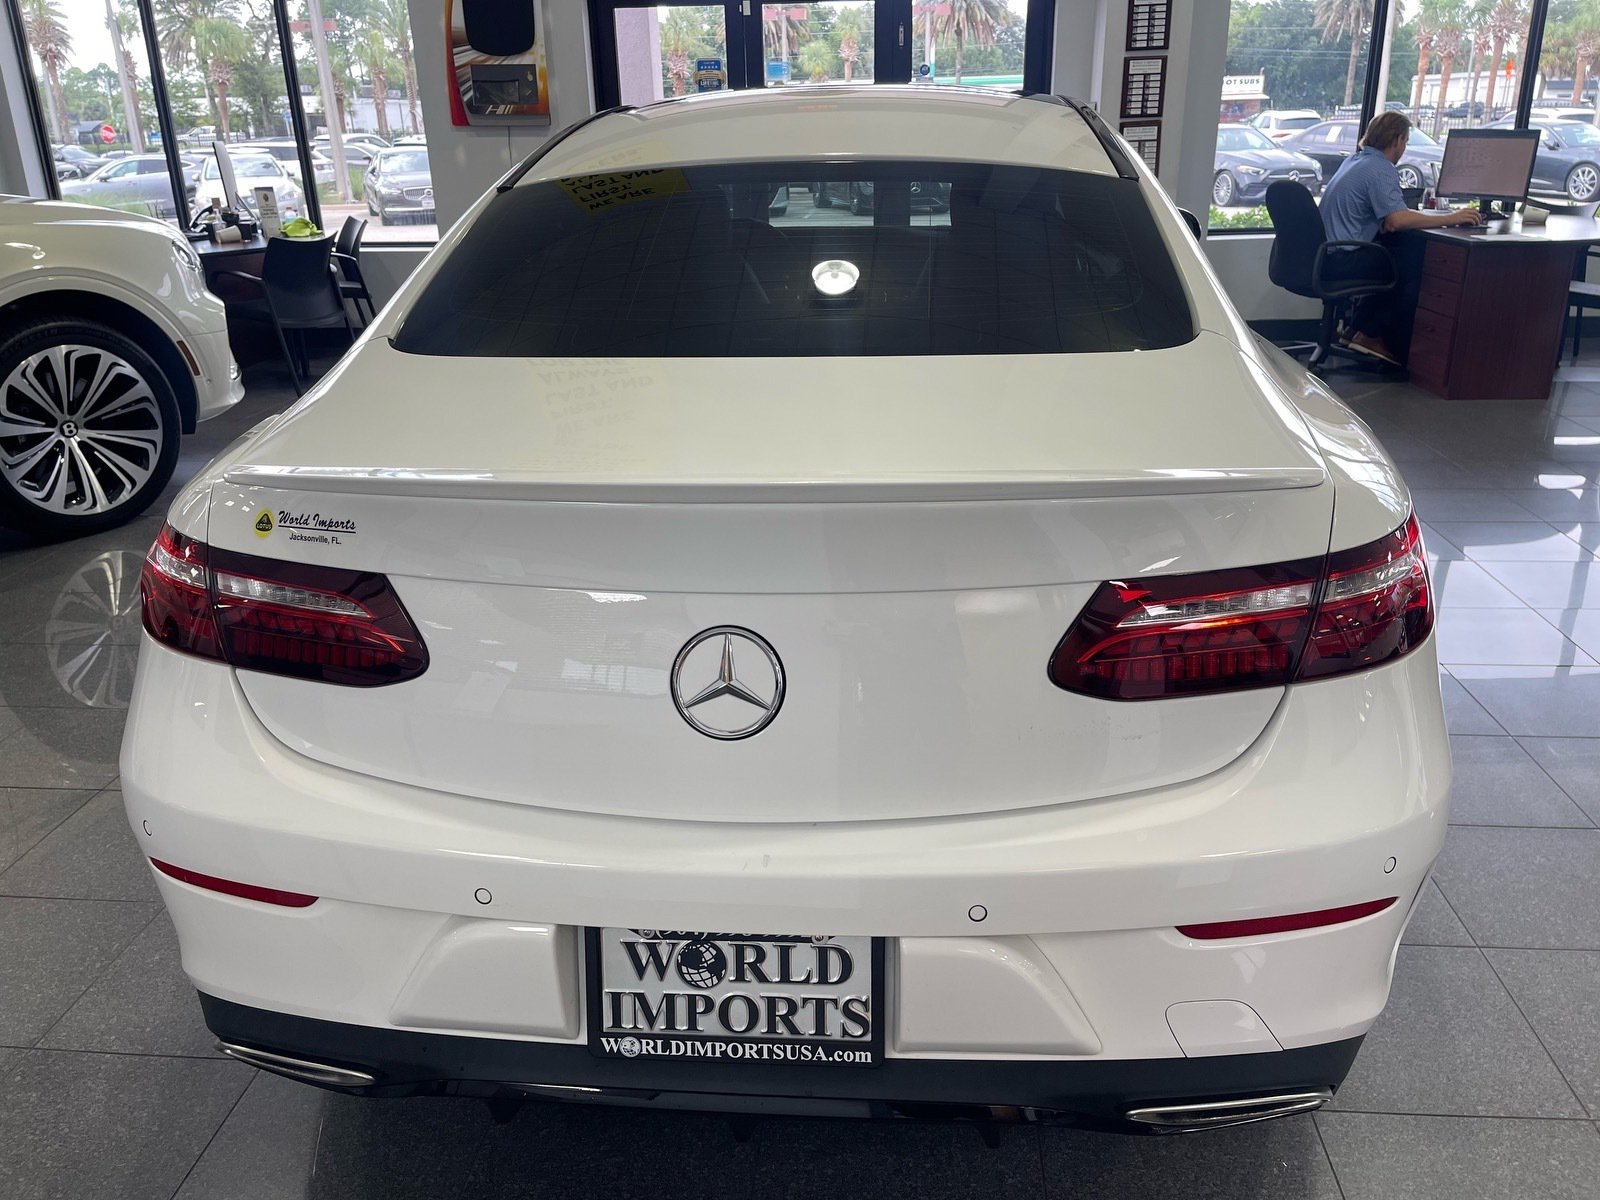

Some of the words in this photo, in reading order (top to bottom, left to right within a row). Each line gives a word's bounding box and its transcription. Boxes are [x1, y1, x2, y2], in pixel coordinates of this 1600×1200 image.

[278, 510, 311, 526] World
[312, 513, 356, 531] Imports
[289, 532, 330, 545] Jacksonville,
[331, 536, 342, 545] FL.
[620, 937, 855, 989] WORLD
[604, 989, 871, 1039] IMPORTS
[599, 1036, 873, 1064] WORLDIMPORTSUSA.com
